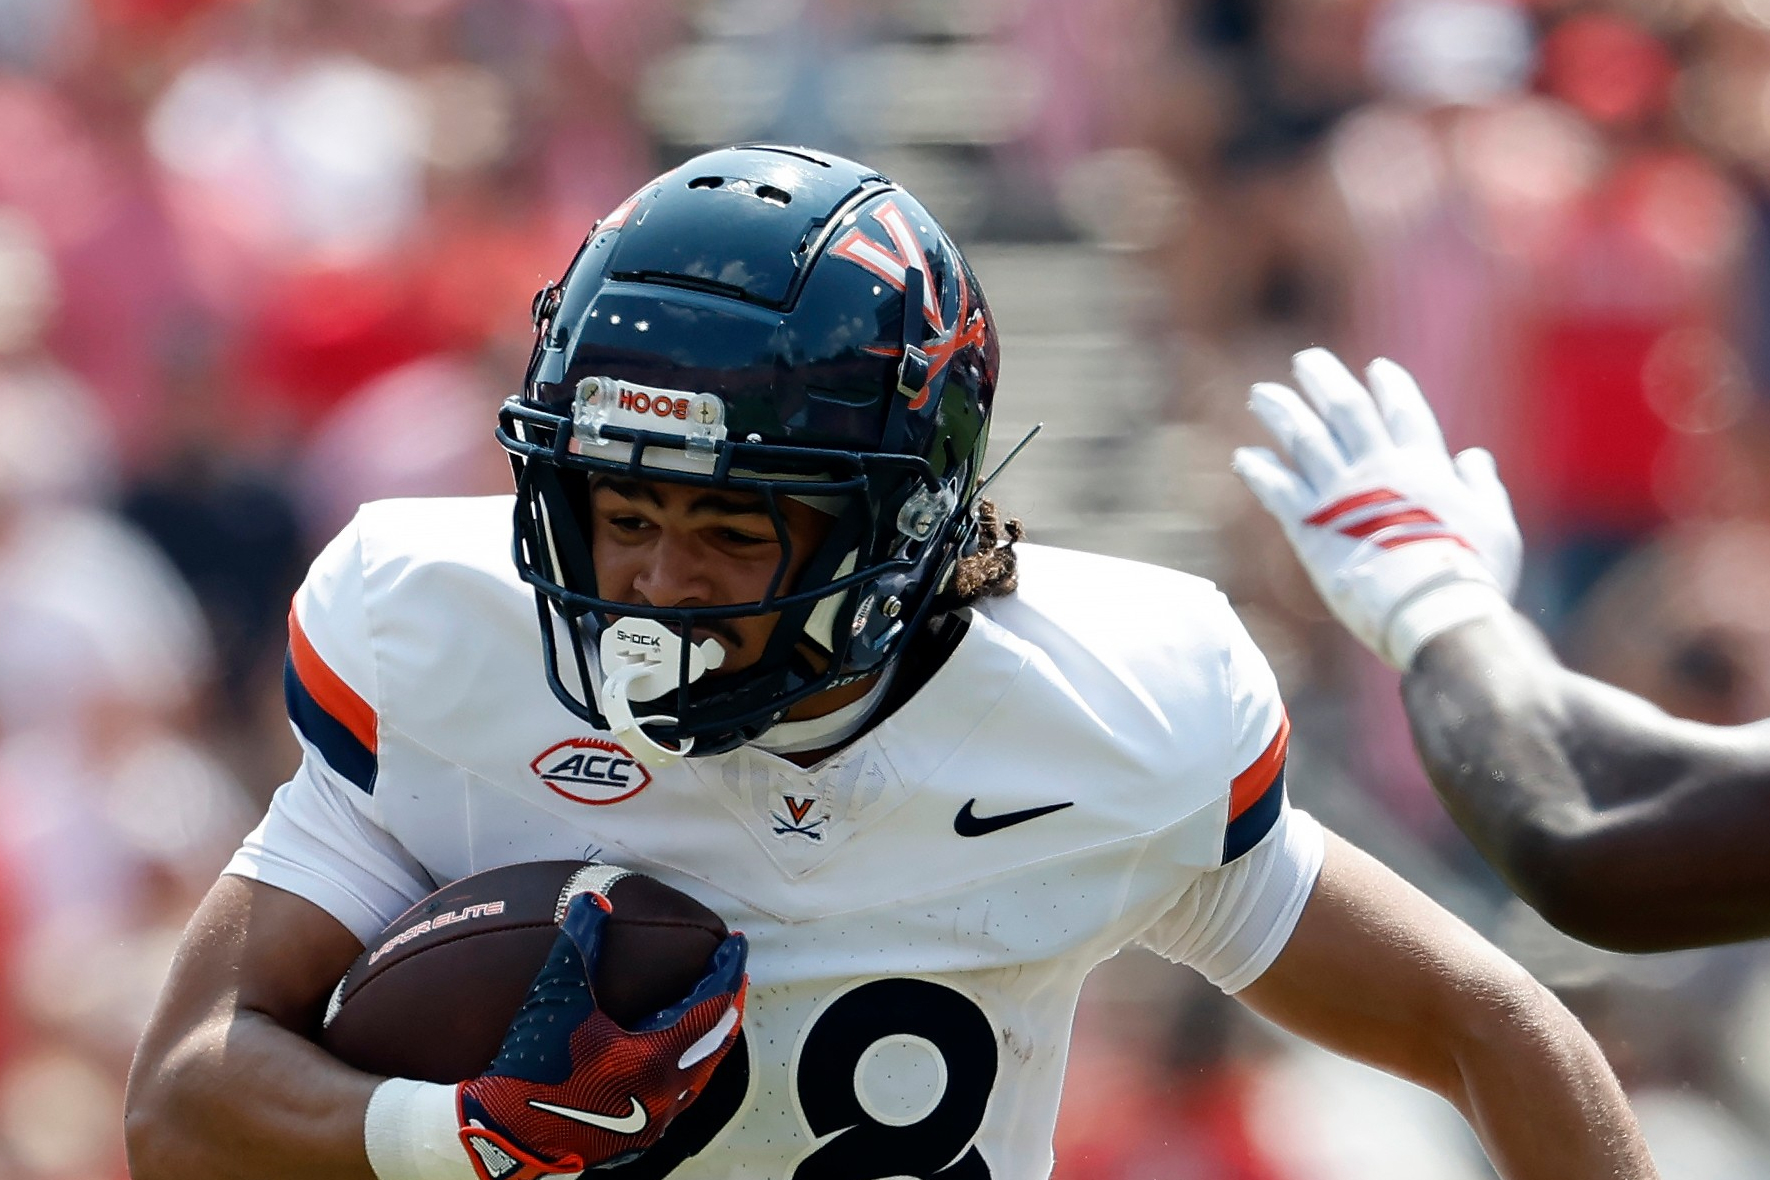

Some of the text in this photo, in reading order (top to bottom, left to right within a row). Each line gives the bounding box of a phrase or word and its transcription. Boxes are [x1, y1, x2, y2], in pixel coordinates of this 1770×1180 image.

[618, 388, 690, 420] HOOS
[616, 629, 662, 648] SHOCK
[550, 753, 636, 782] ACC
[432, 900, 505, 929] ELITE
